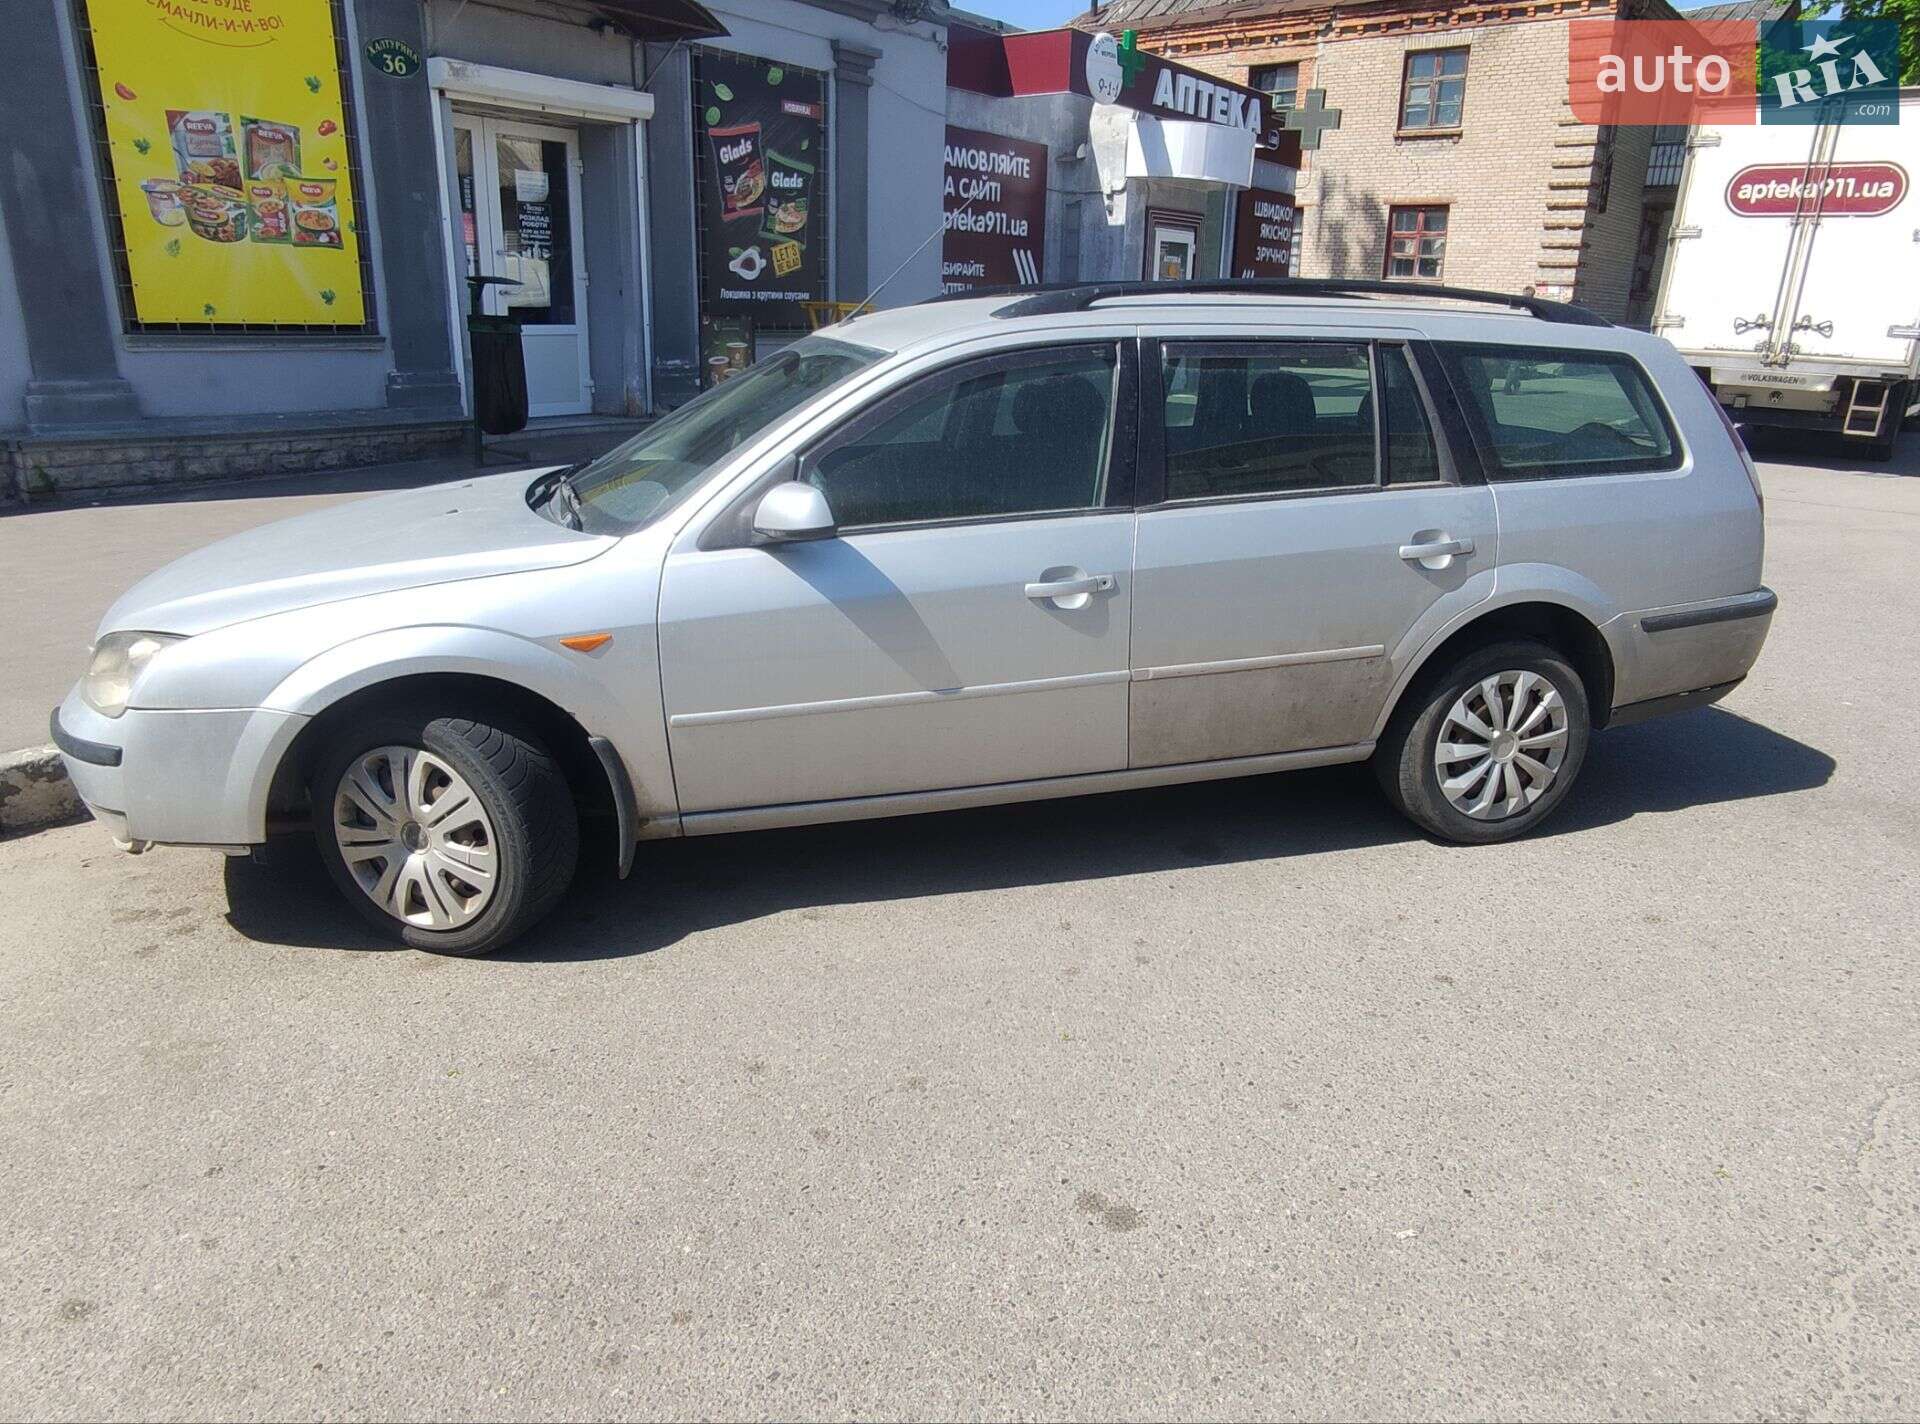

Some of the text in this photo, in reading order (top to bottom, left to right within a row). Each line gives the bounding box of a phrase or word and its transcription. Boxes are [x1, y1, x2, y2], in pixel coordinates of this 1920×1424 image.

[383, 54, 406, 75] 36
[1098, 78, 1120, 98] 9-1-1
[1152, 68, 1262, 135] АПТЕКА
[187, 122, 214, 131] REEVA
[258, 130, 284, 140] REEVA
[720, 139, 752, 164] Glads
[944, 145, 1030, 178] АМОВЛЯЙТЕ
[772, 172, 803, 188] Glads
[944, 175, 1000, 202] А САЙТІ
[1737, 177, 1895, 204] apteka911.ua
[519, 214, 549, 223] РОЗКЛАД
[943, 207, 1028, 236] pteka911.ua
[1254, 201, 1293, 222] ШВИДКО!
[1260, 223, 1291, 242] ЯКІСНО!
[1256, 246, 1289, 264] ЗРУЧНО!
[943, 258, 985, 277] БИРАЙТЕ
[1747, 374, 1801, 384] VOLKSWAGEN
